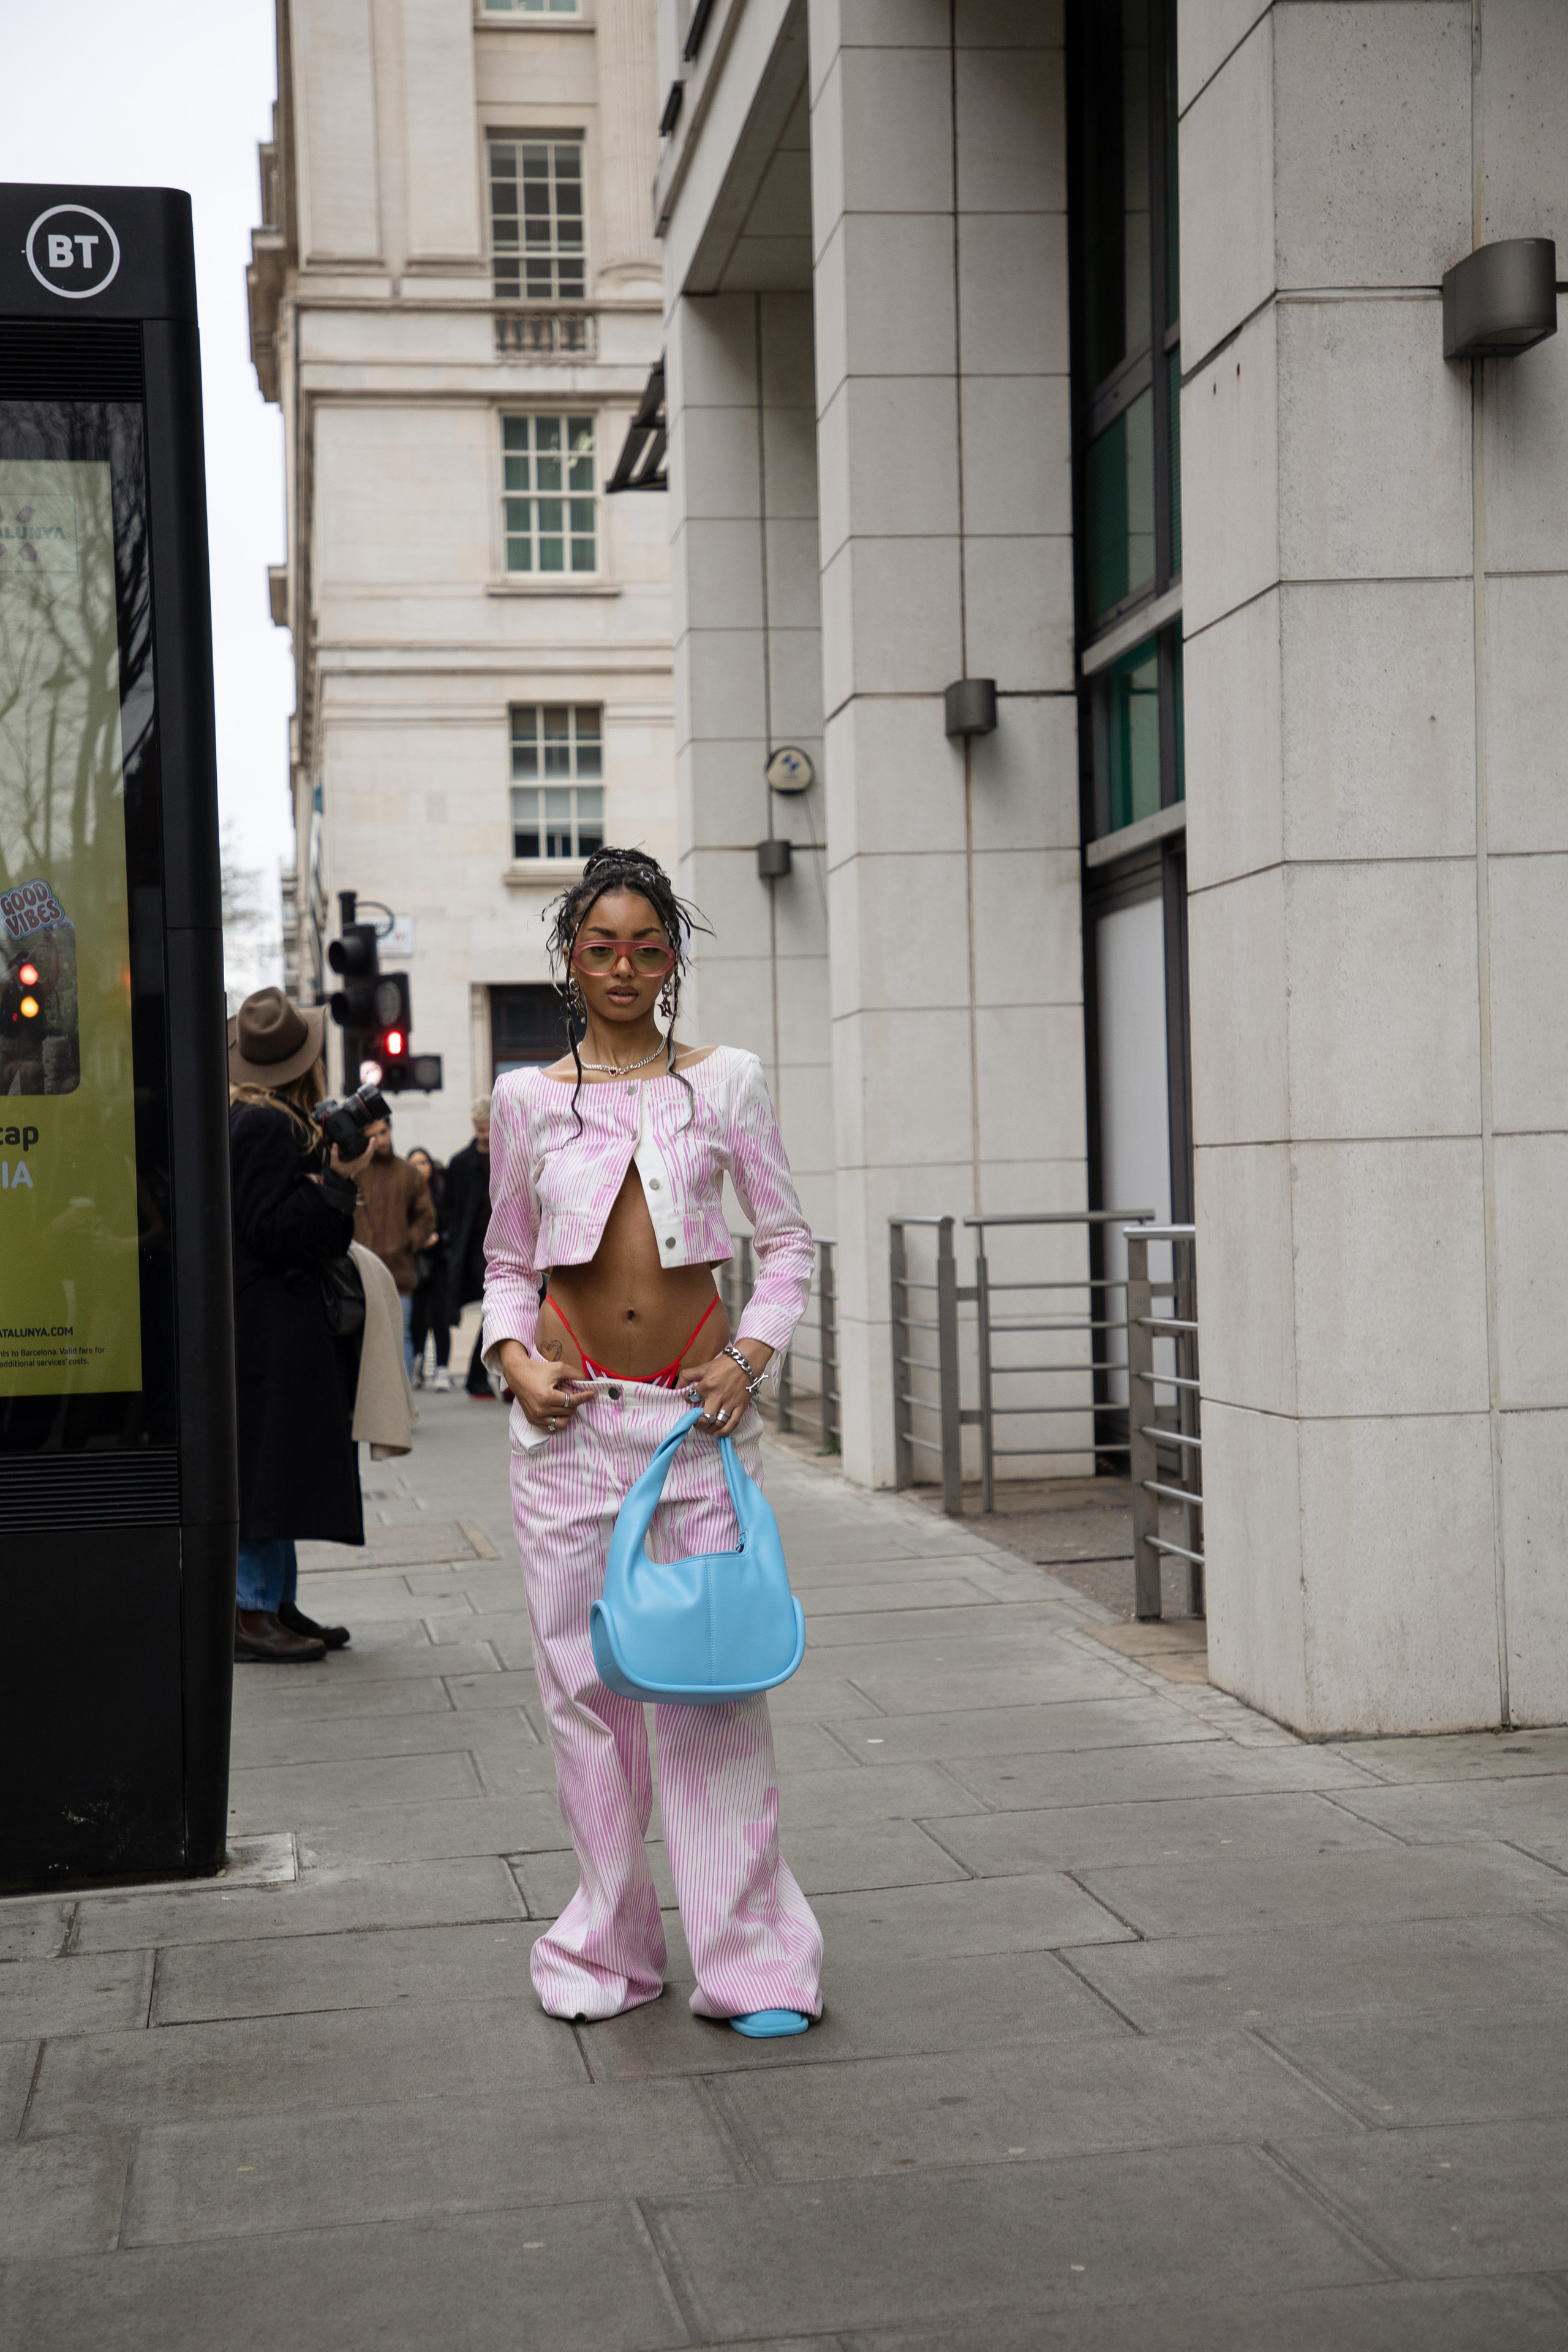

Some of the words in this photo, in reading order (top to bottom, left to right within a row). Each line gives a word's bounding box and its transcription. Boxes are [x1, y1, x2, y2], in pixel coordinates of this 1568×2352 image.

[47, 235, 99, 268] BT
[1, 883, 48, 916] GOOD
[6, 900, 61, 936] VIBES
[0, 1126, 39, 1152] ap
[0, 1359, 35, 1368] additional
[21, 1348, 58, 1356] Barcelona.
